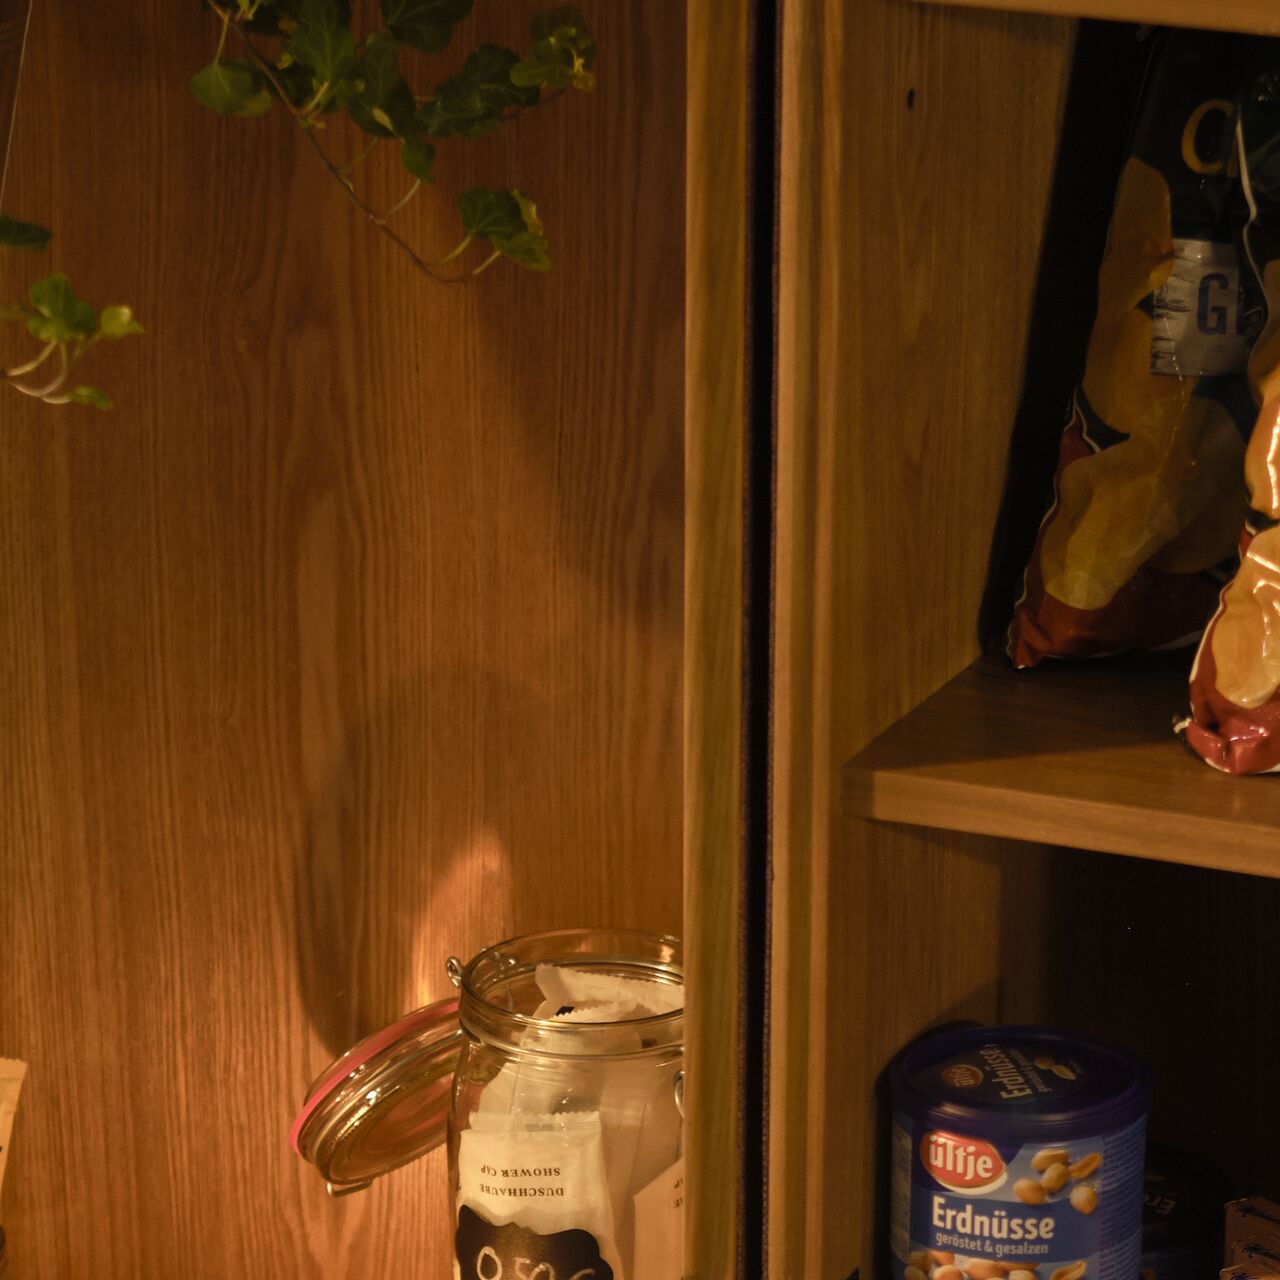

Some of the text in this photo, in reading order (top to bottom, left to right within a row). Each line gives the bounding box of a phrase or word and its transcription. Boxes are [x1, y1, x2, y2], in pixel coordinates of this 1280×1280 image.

[501, 1165, 561, 1178] SHOWER
[928, 1136, 993, 1180] ültje
[931, 1195, 1055, 1239] Erdnüsse
[935, 1231, 1049, 1258] geröstet & gesalzen
